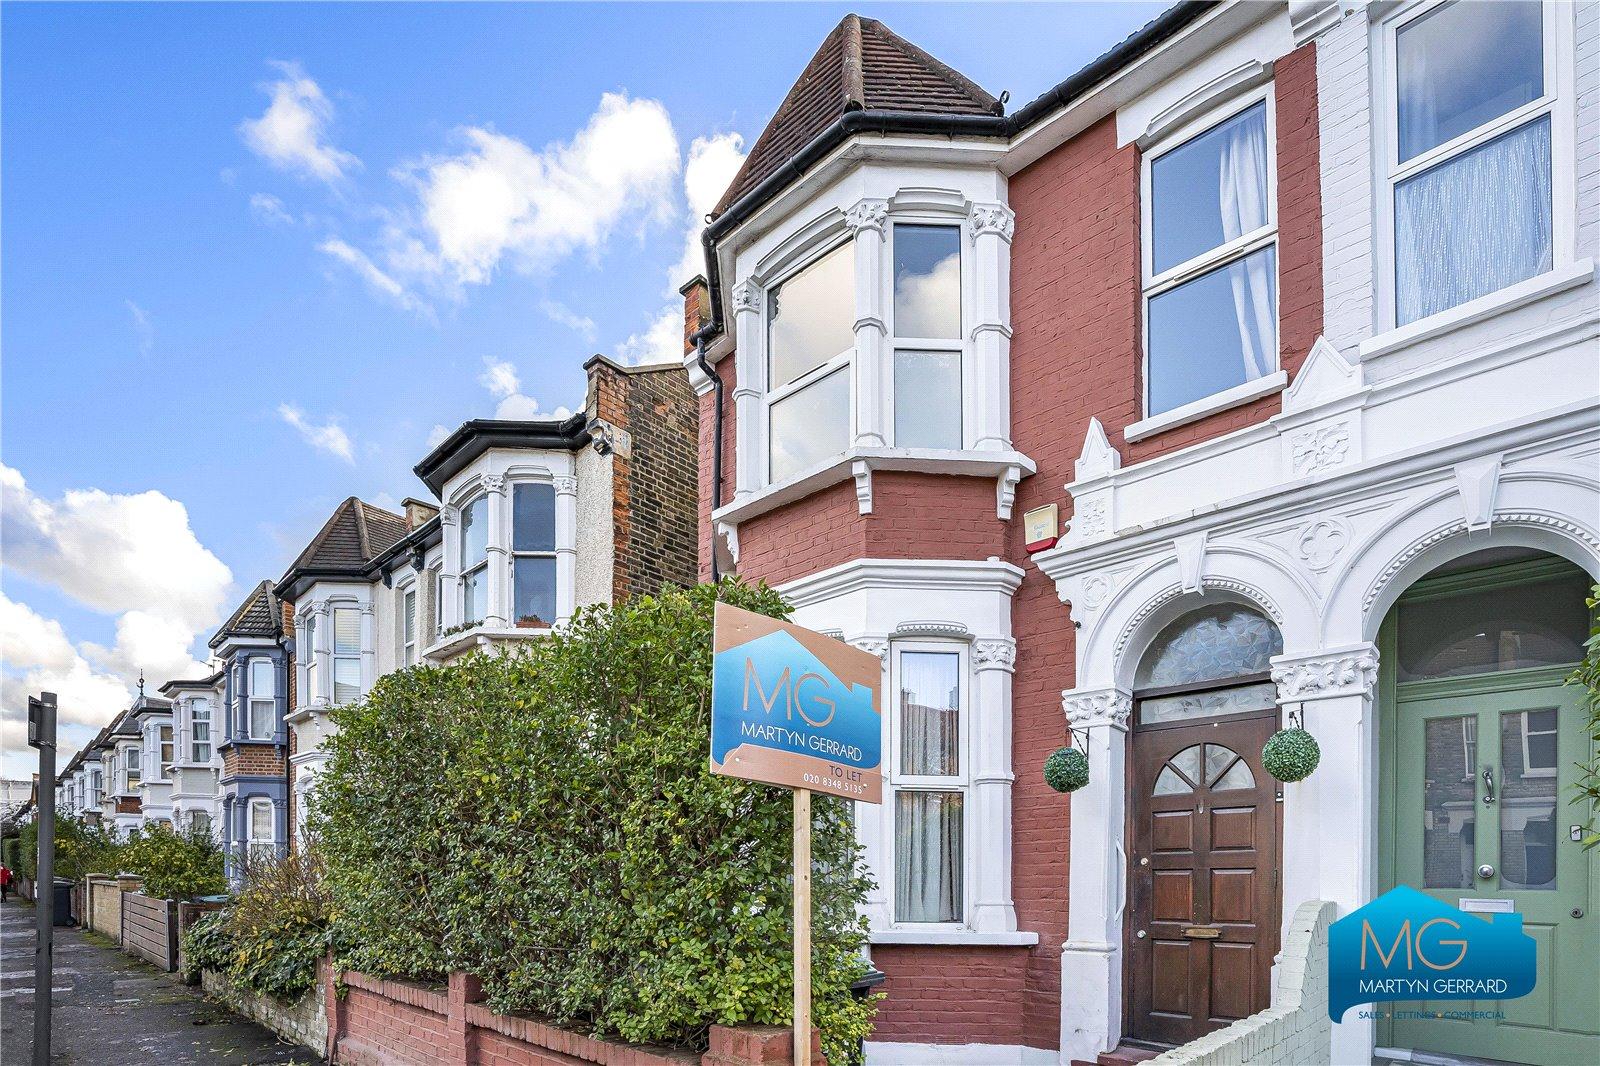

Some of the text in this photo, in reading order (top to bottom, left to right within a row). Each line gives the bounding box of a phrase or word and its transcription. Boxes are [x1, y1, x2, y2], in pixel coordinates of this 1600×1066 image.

[743, 656, 837, 727] MG
[741, 720, 863, 761] MARTYN GERRARD
[803, 773, 820, 785] 020
[823, 777, 842, 790] 8348
[829, 765, 863, 782] TO LET
